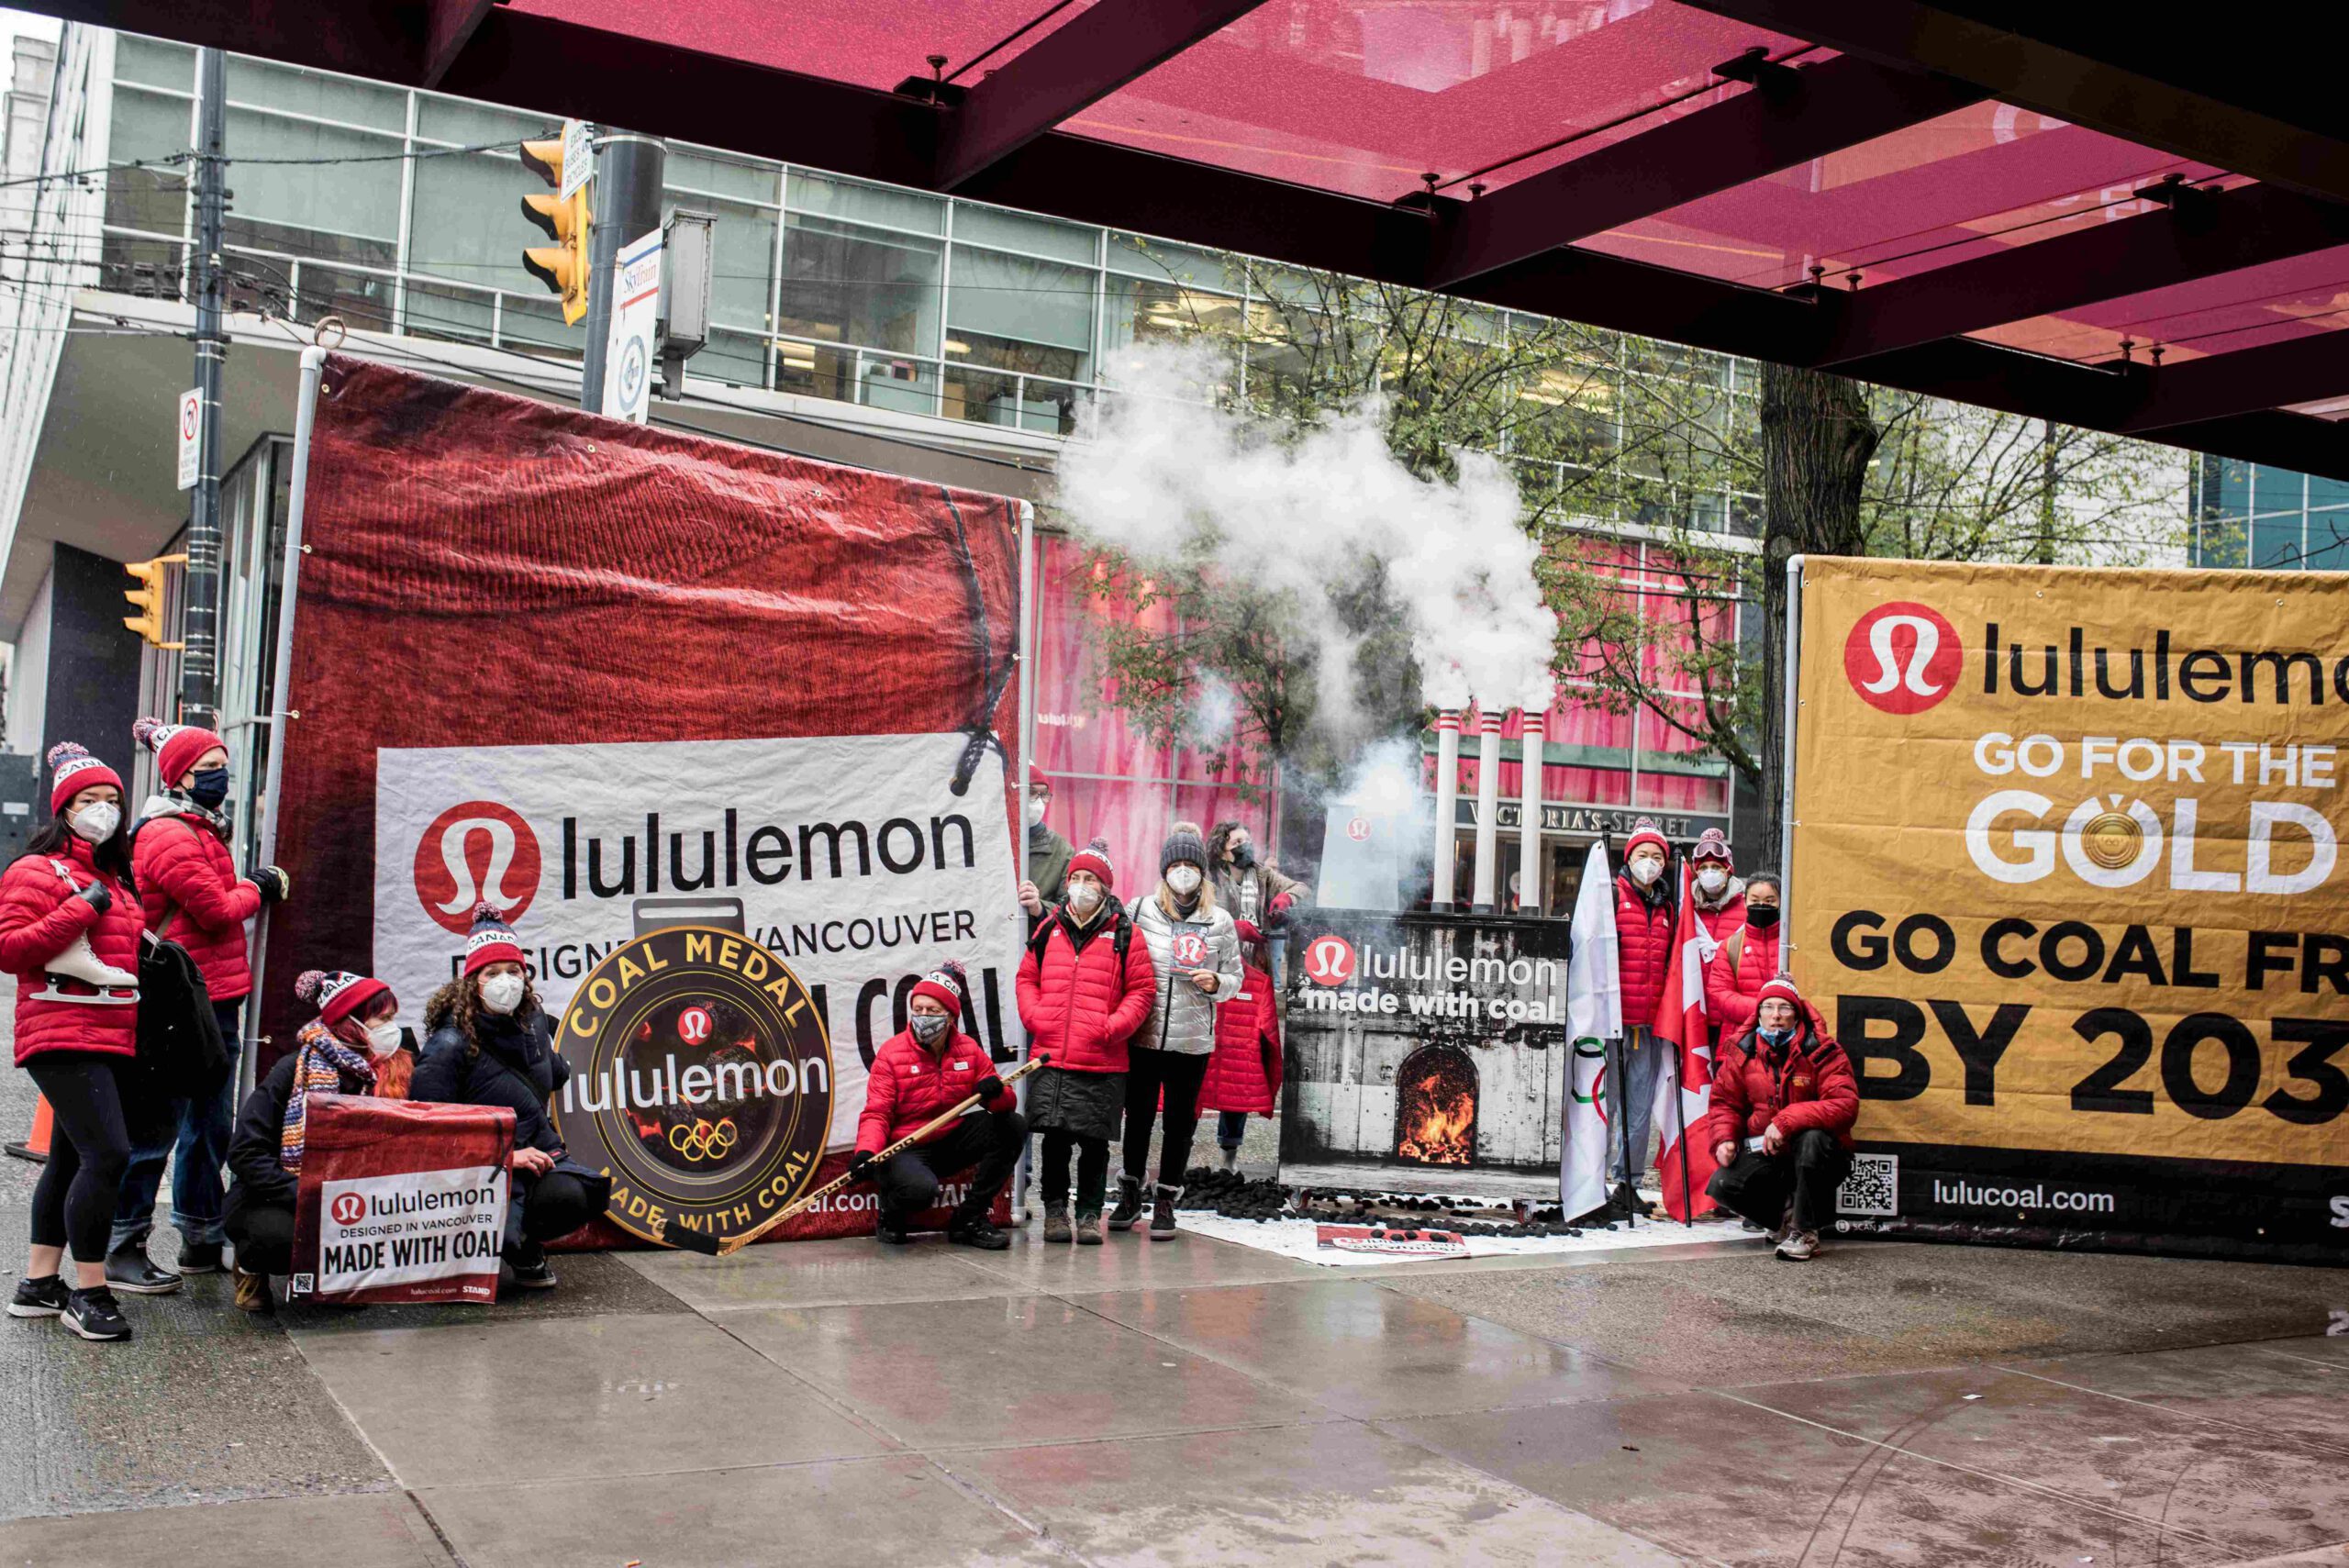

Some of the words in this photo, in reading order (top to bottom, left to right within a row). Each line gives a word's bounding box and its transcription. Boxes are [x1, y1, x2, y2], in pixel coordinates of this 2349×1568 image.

[624, 262, 657, 294] SkyTrain
[1984, 623, 2349, 706] lululem
[1974, 731, 2065, 778] GO
[2081, 736, 2206, 783] FOR
[2220, 740, 2337, 788] THE
[1469, 801, 1602, 832] VCTRIA'S
[1611, 811, 1691, 837] SERET
[562, 807, 975, 900] lululemon
[1965, 789, 2338, 895] GOLD
[1363, 944, 1557, 986] lululemon
[1830, 909, 1956, 974] GO
[1979, 917, 2220, 988] COAL
[570, 942, 669, 1039] COAL
[685, 933, 807, 1029] MEDAL
[1305, 987, 1399, 1013] made
[1408, 990, 1479, 1018] with
[1487, 995, 1556, 1021] coal
[1836, 994, 2033, 1106] BY
[562, 1053, 829, 1114] lululemon
[372, 1187, 495, 1217] lululemon
[679, 1203, 752, 1235] WITH
[758, 1148, 812, 1209] COAL
[1933, 1179, 2115, 1213] lulucoal.com
[340, 1223, 402, 1239] DESIGNED
[406, 1221, 417, 1232] IN
[422, 1214, 493, 1230] VANCOUVER
[1853, 1222, 1876, 1232] SCAN
[324, 1240, 385, 1275] MADE
[392, 1235, 446, 1268] WITH
[452, 1230, 502, 1260] COAL
[462, 1285, 491, 1296] STAND
